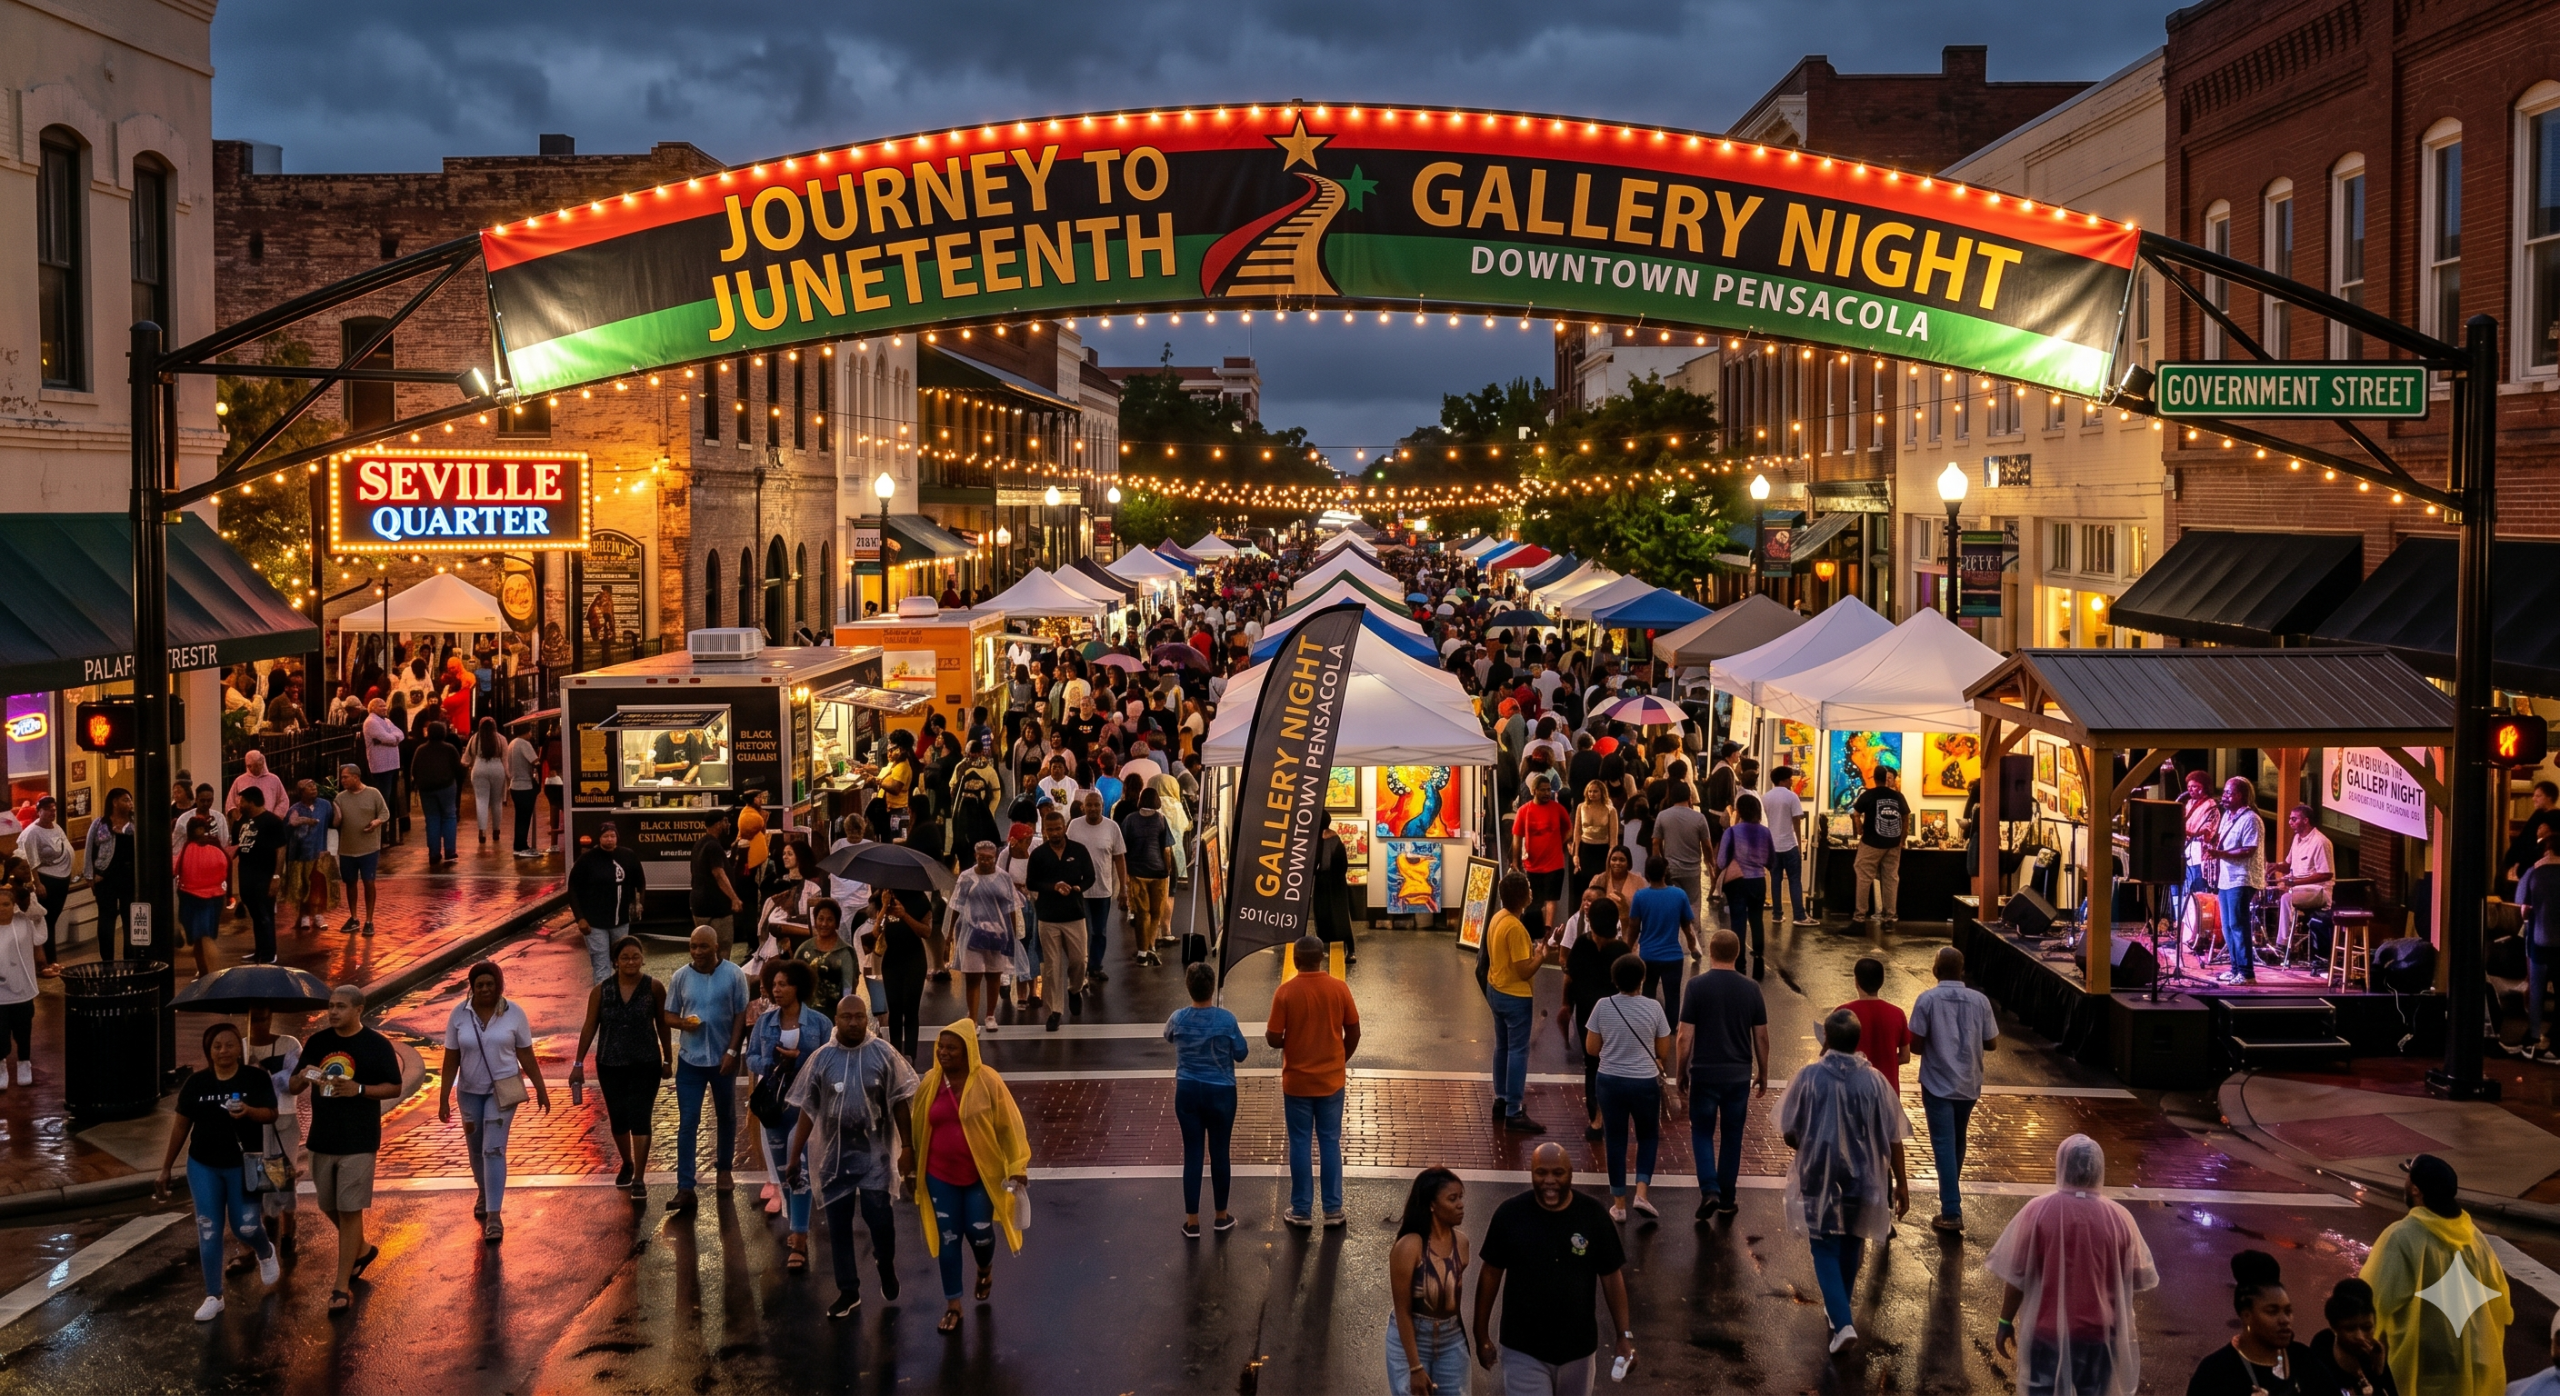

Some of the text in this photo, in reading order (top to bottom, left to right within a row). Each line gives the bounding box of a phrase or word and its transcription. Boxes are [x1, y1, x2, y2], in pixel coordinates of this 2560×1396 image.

[720, 144, 1169, 262] JOURNEY TO
[1412, 161, 2023, 311] GALLERY NIGHT
[708, 212, 1177, 342] JUNETEENTH
[1471, 246, 1929, 342] DOWNTOWN PENSACOLA
[2167, 374, 2415, 406] GOVERNMENT STREET
[359, 461, 562, 501] SEVILLE
[372, 506, 550, 541] QUARTER
[84, 655, 135, 681] PALAF
[740, 730, 772, 739] BLACK
[1255, 634, 1324, 897] GALLERY NIGHT
[1284, 643, 1346, 902] DOWNTOWN PENSACOLA
[2390, 781, 2424, 807] NIGHT
[640, 821, 671, 830] BLACK
[1239, 907, 1298, 929] 501(c)(3)
